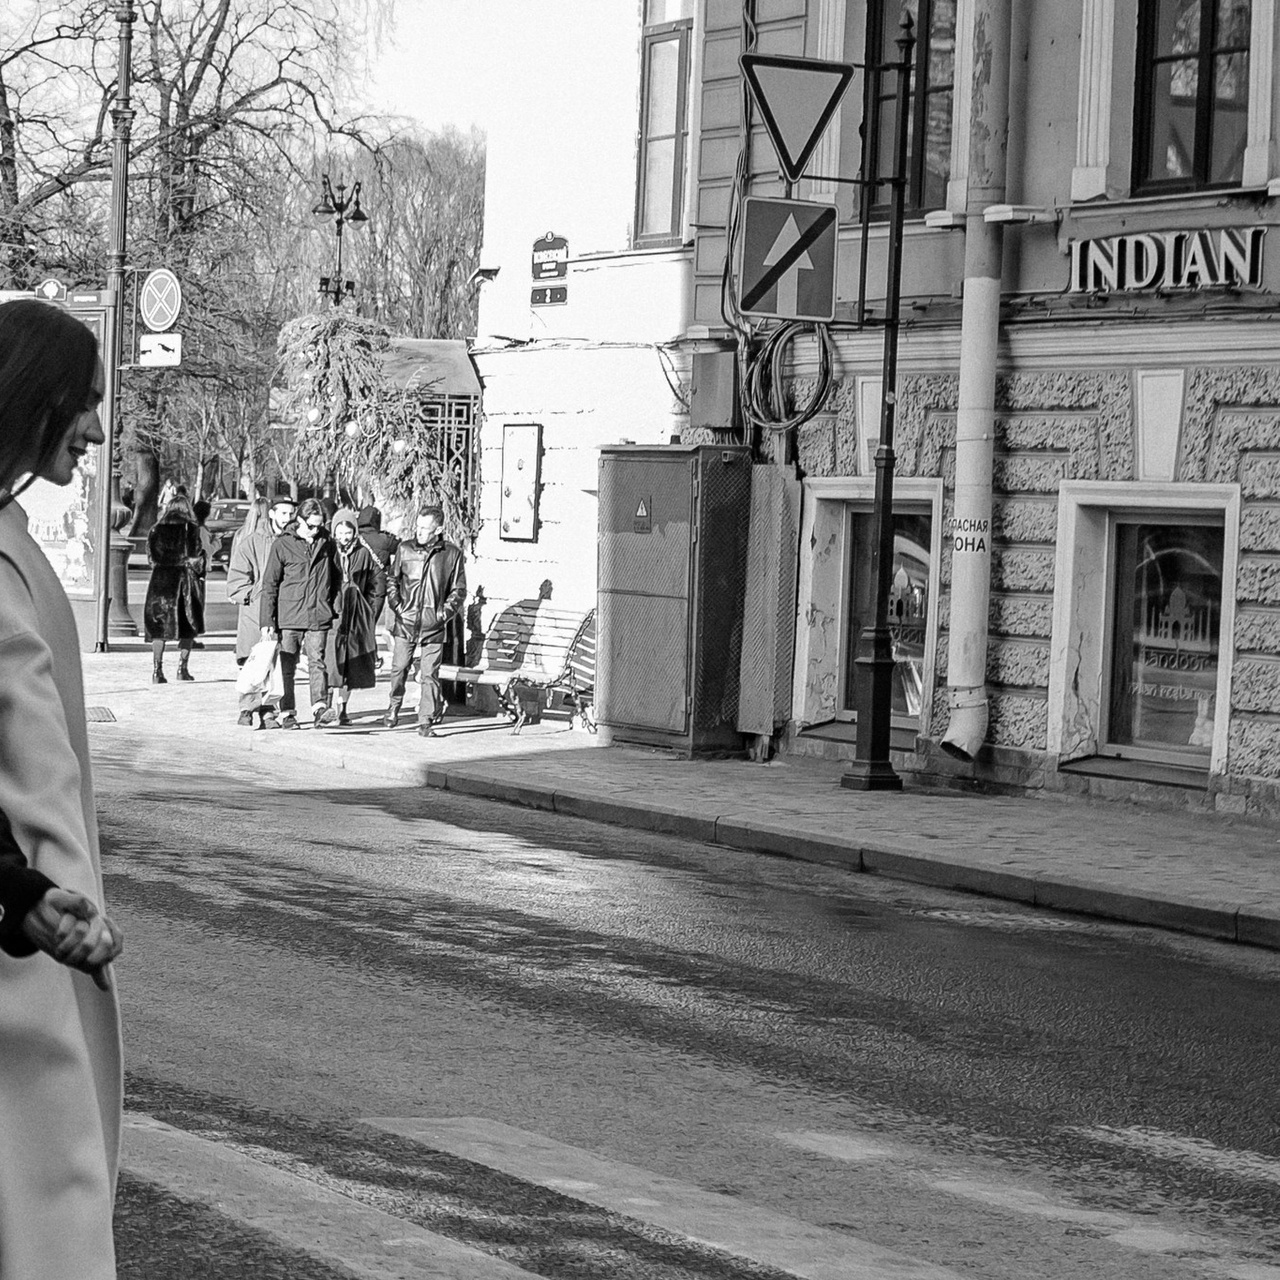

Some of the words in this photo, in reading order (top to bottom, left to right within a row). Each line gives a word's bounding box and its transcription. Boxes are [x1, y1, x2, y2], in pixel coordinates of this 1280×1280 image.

[1070, 227, 1267, 293] INDIAN
[948, 519, 989, 532] ПАСНАЯ
[954, 536, 986, 552] ОНА
